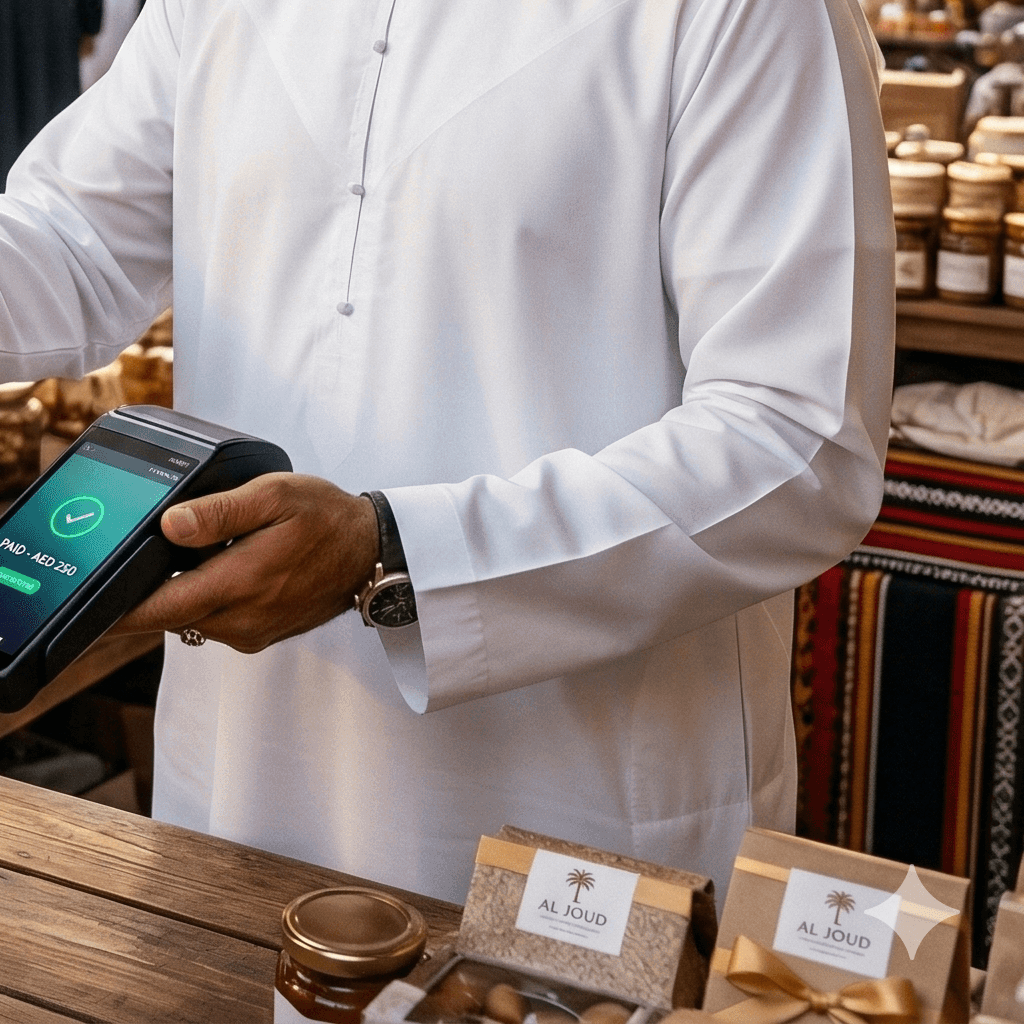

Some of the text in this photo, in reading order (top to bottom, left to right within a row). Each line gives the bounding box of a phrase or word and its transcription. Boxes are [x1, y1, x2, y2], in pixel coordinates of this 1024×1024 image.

[30, 551, 56, 568] AED
[53, 560, 78, 577] 250
[537, 898, 559, 915] AL
[562, 904, 608, 927] JOUD
[796, 920, 819, 937] AL
[822, 926, 872, 950] JOUD
